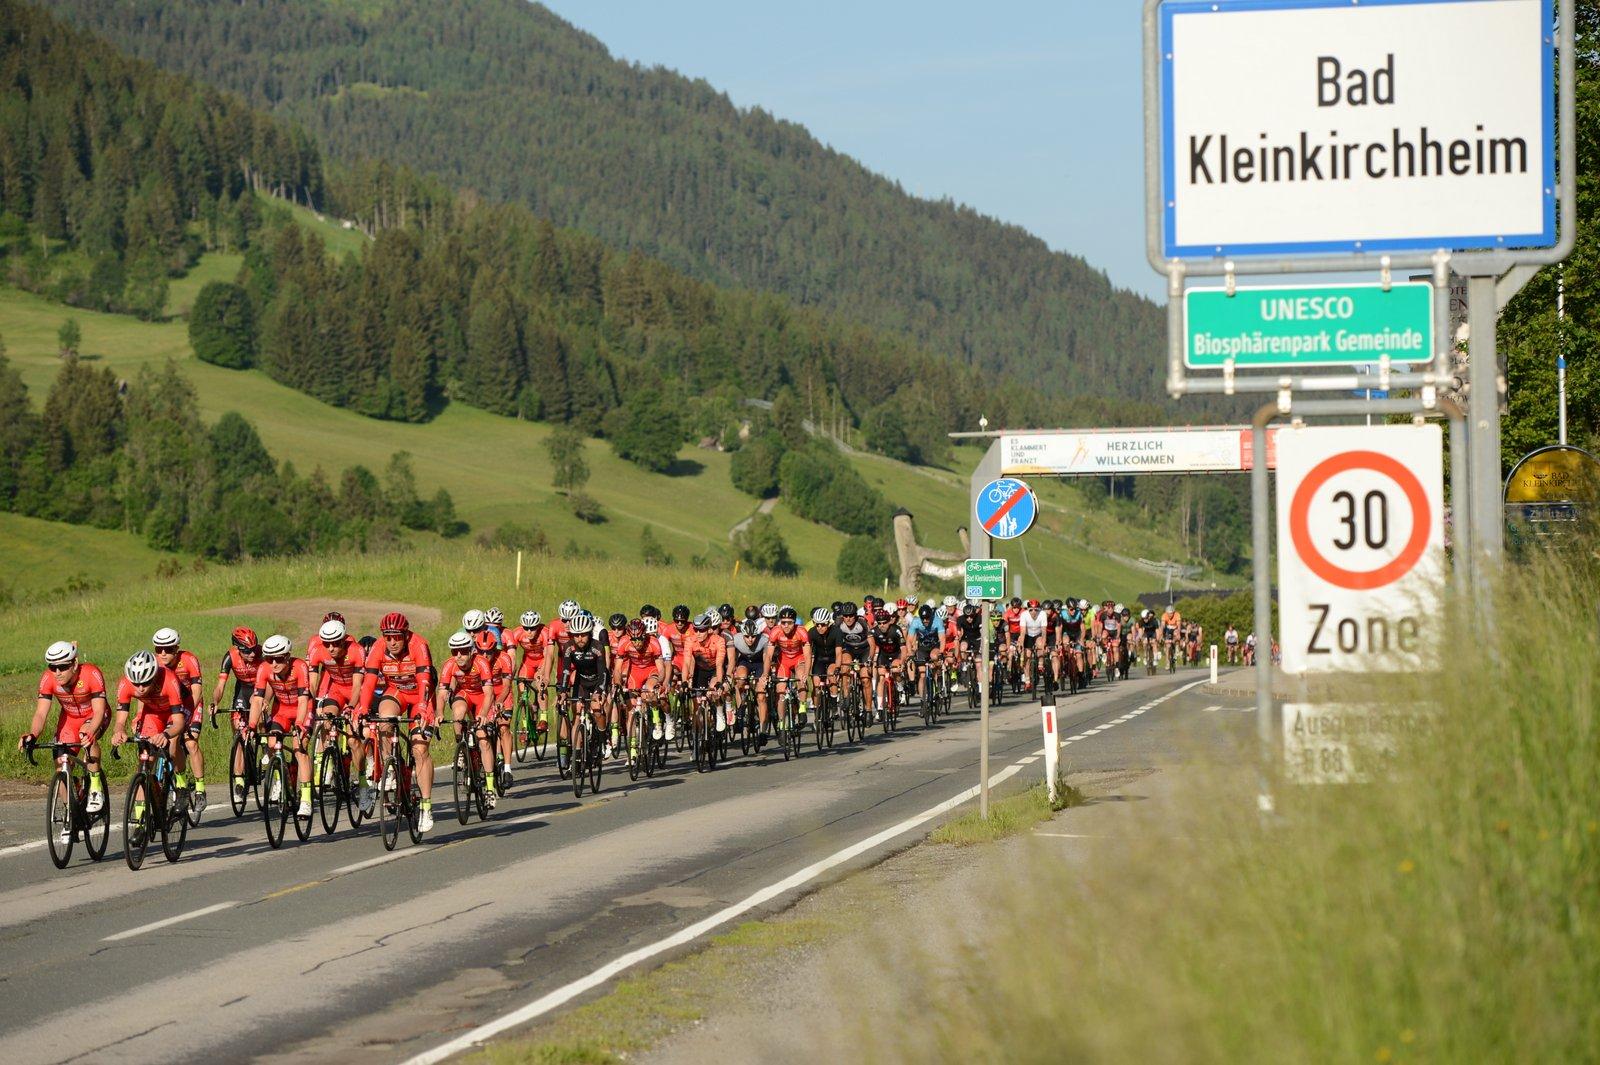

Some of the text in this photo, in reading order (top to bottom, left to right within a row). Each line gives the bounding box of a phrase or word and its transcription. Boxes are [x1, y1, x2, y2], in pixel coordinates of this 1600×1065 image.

[1317, 53, 1395, 108] Bad
[1189, 125, 1528, 185] Kleinkirchheim
[1260, 296, 1354, 321] UNESCO
[1193, 327, 1423, 357] Biosphärenpark Gemeinde
[1107, 440, 1163, 451] HERZLICH
[1095, 455, 1175, 466] WILLKOMMEN
[1551, 472, 1570, 480] BAD
[1331, 489, 1389, 551] 30
[966, 574, 974, 582] Bad
[1306, 603, 1420, 654] Zone
